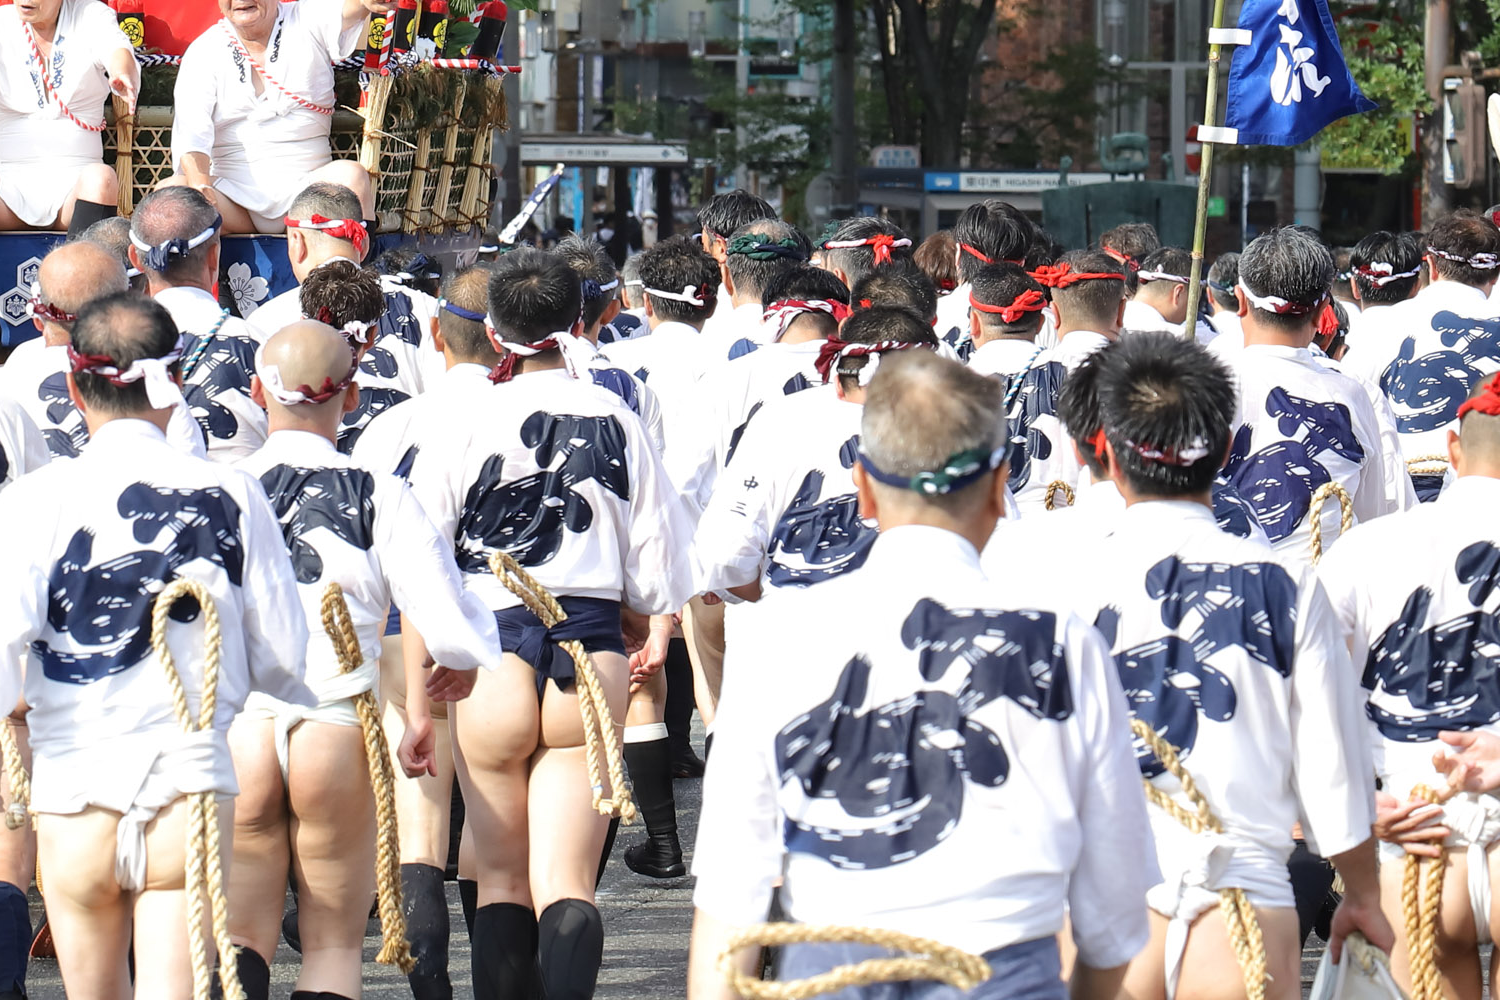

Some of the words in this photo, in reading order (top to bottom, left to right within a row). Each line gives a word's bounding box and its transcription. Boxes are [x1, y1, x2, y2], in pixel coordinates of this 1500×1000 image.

[965, 176, 1001, 188] 東中洲
[729, 475, 760, 517] 中三
